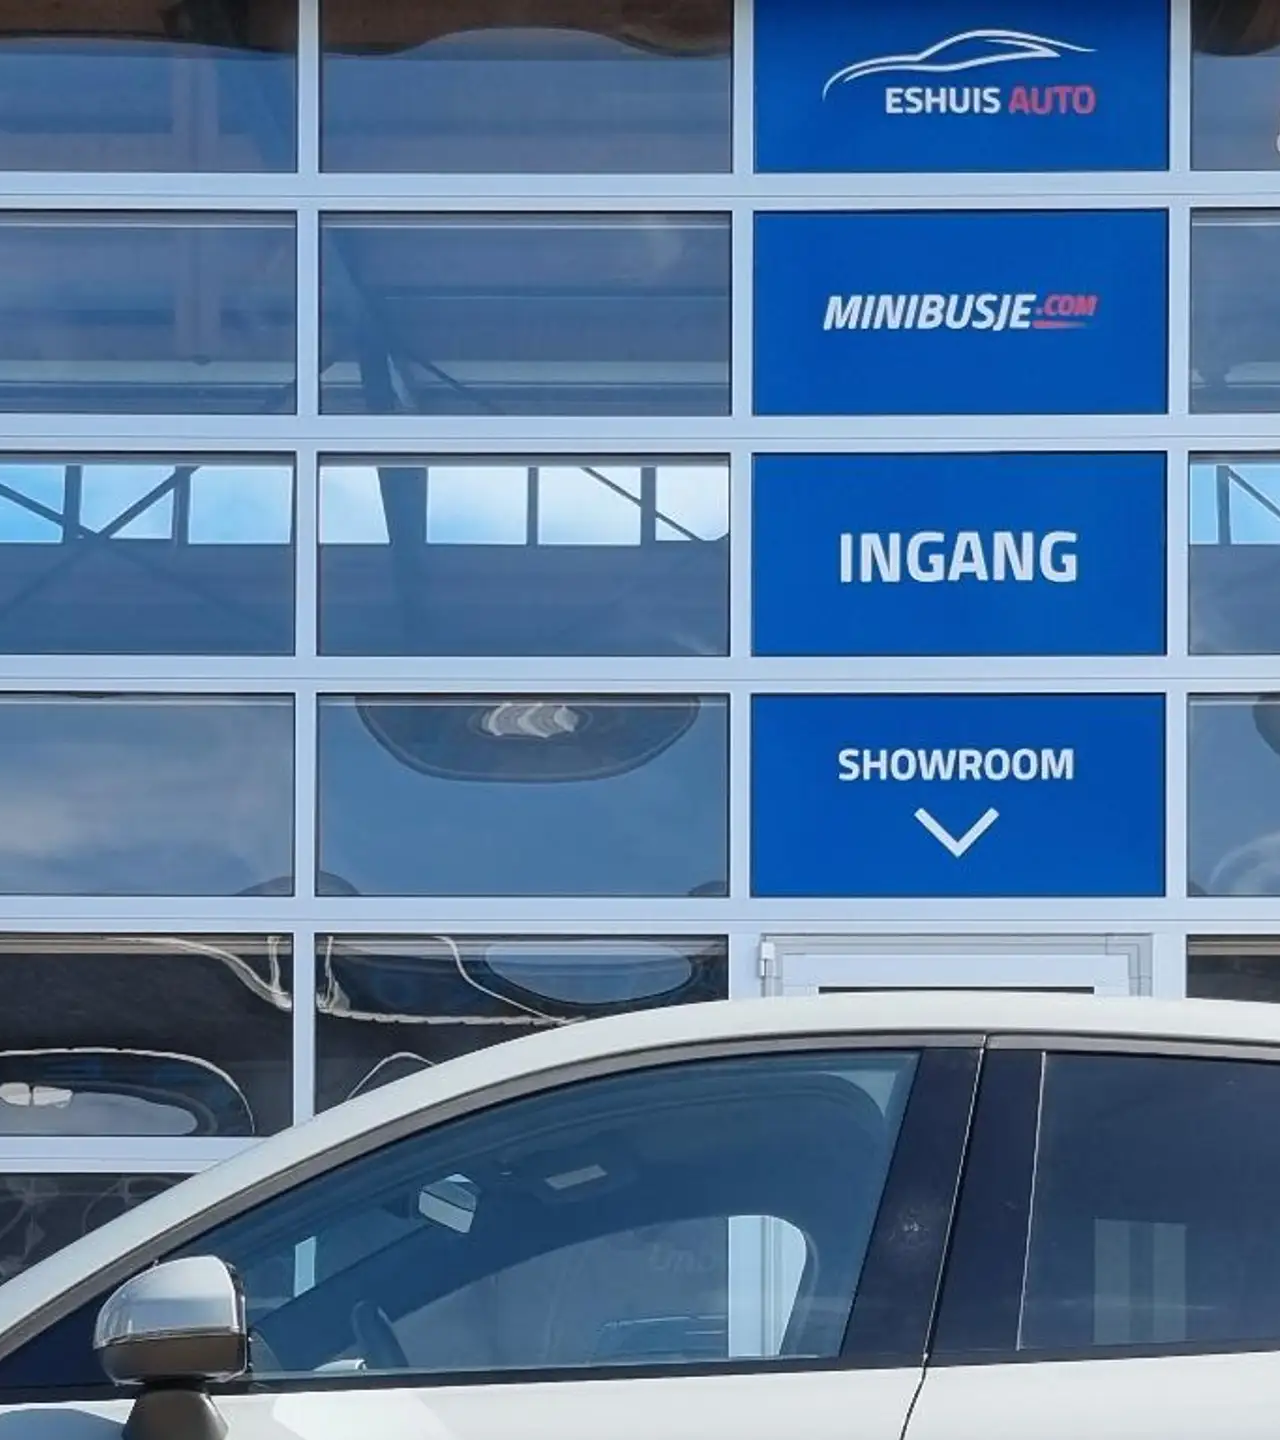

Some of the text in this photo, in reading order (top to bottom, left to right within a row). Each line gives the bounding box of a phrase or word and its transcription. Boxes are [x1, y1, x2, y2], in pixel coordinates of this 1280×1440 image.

[884, 85, 1097, 115] ESHUIS AUTO
[839, 530, 1078, 583] INGANG
[837, 747, 1075, 781] SHOWROOM
